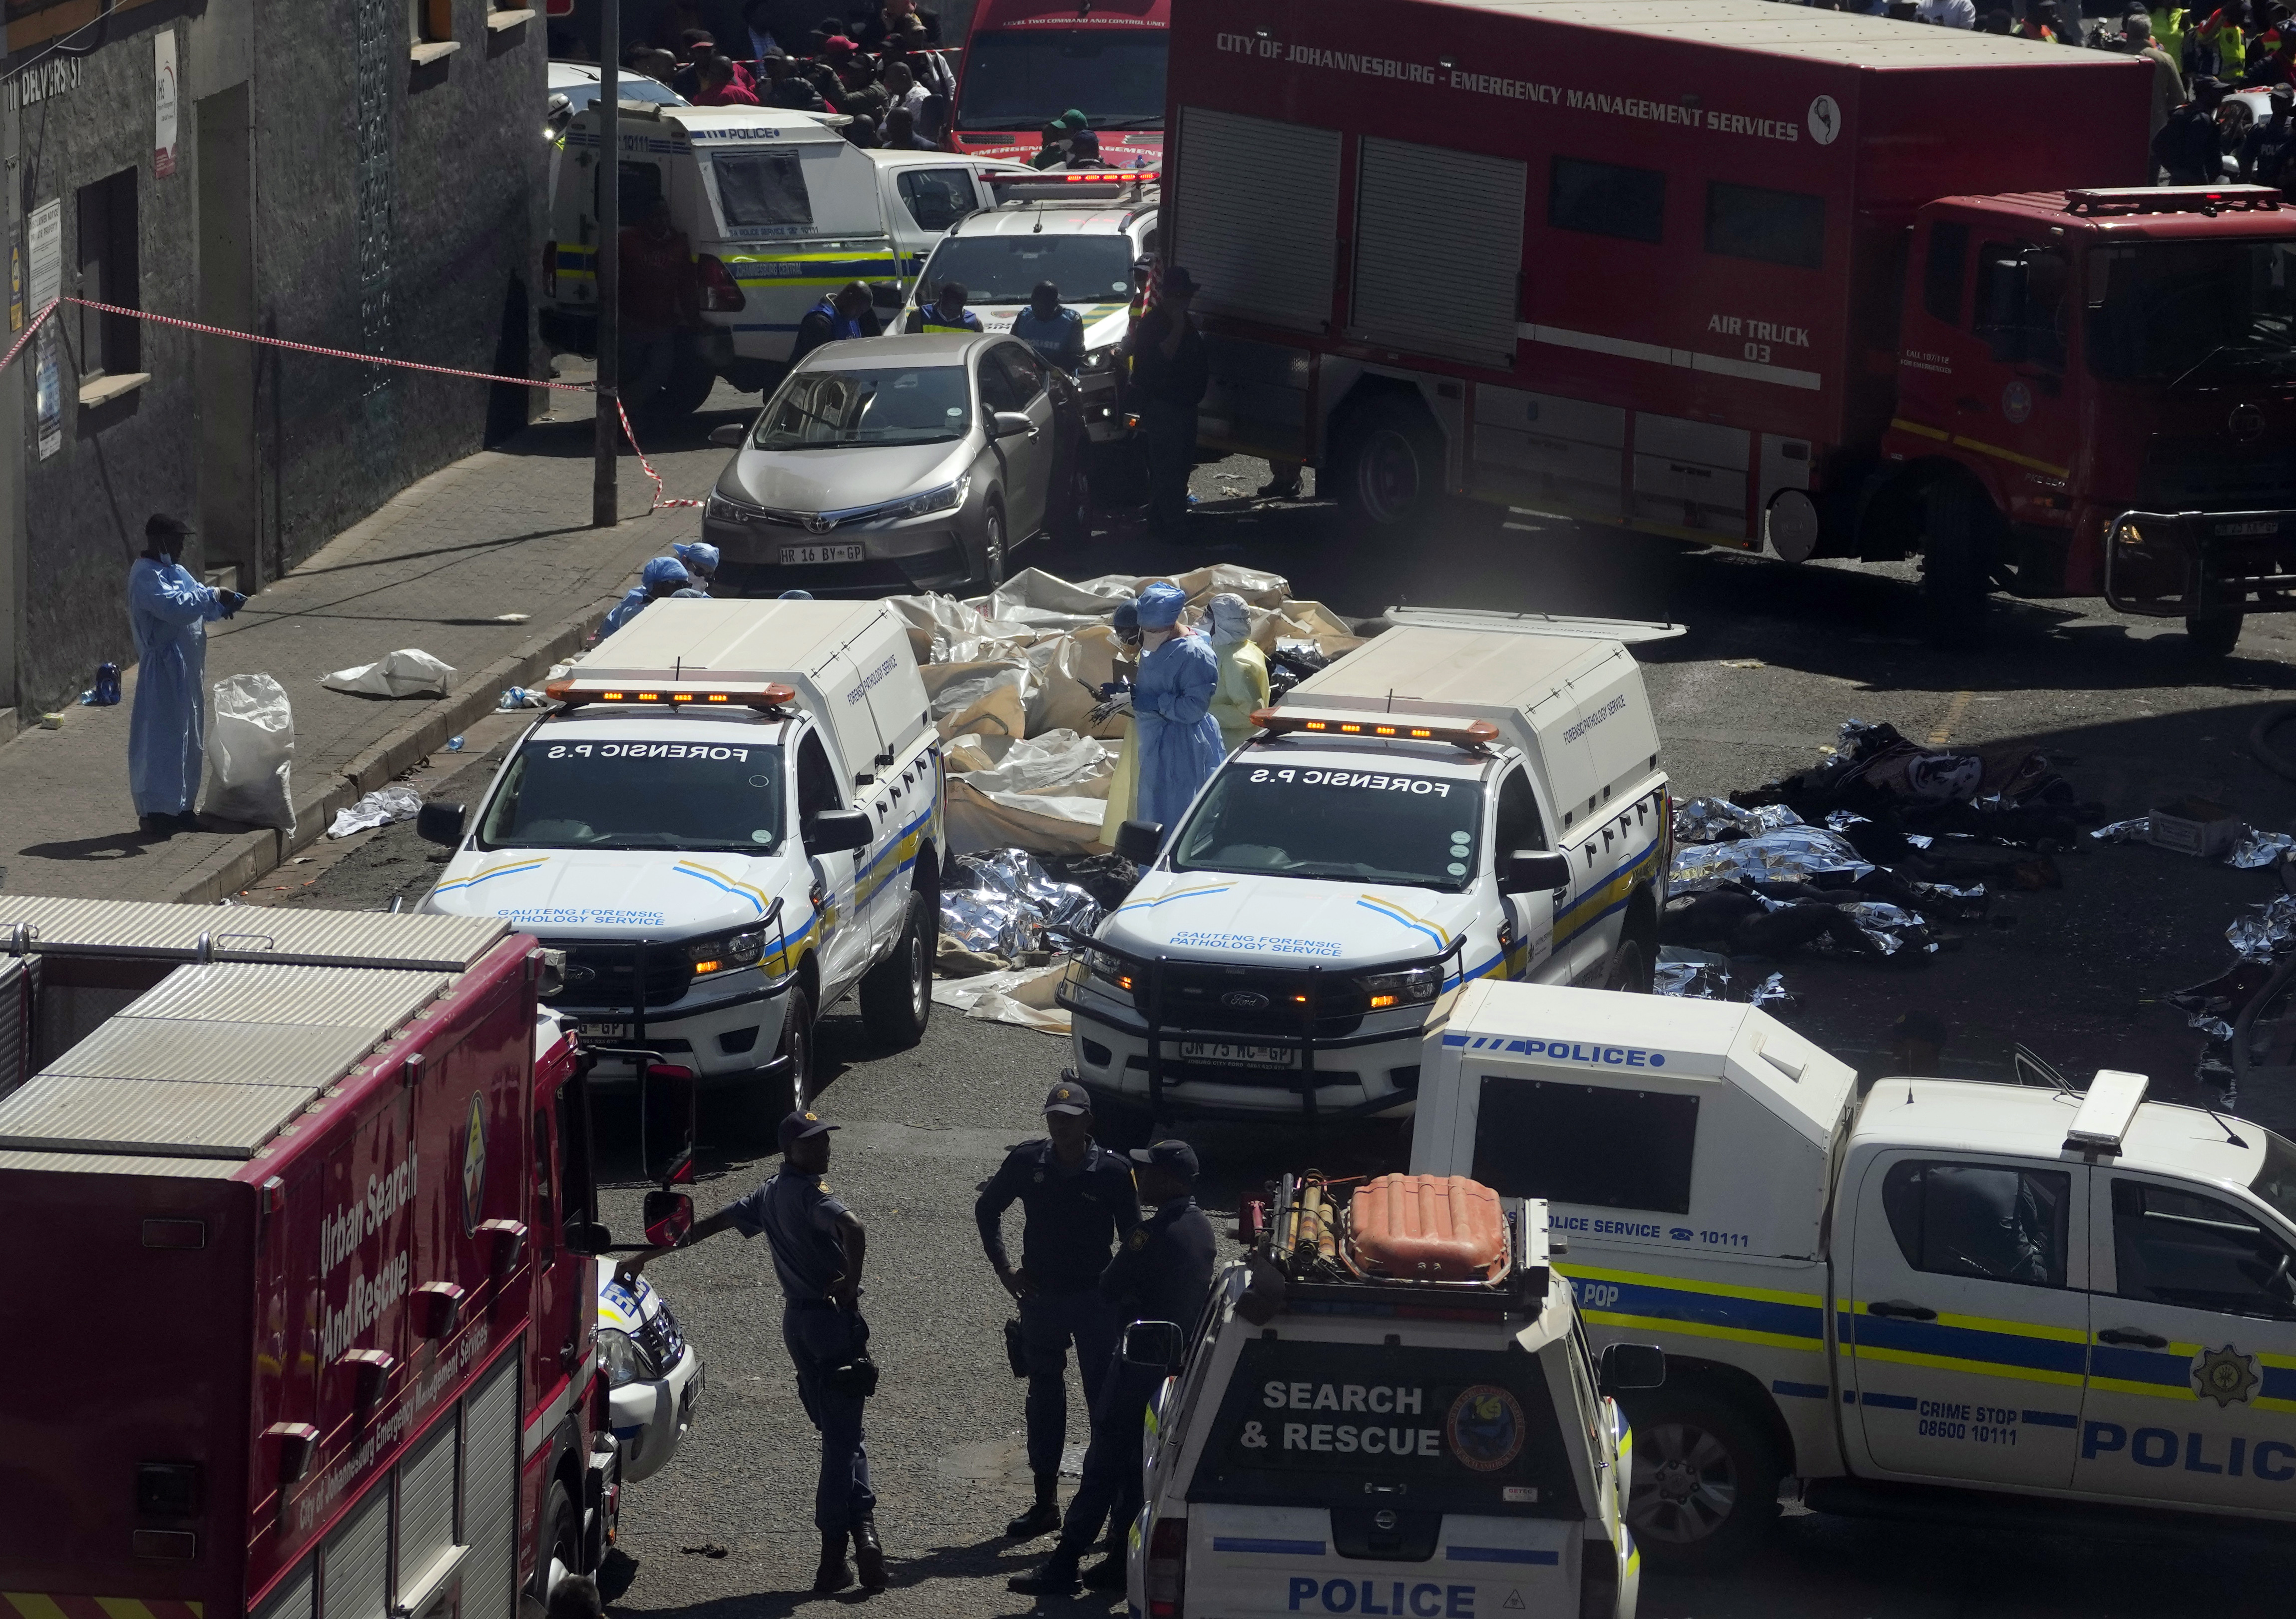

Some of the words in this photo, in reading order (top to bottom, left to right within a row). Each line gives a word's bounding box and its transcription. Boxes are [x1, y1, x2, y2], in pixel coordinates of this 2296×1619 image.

[22, 57, 66, 106] DELVERS
[70, 56, 81, 89] ST
[1217, 32, 1255, 55] CITY
[1260, 40, 1282, 59] OF
[1285, 44, 1434, 85] JOHANNESBURG
[1450, 70, 1562, 105] EMERGENCY
[1566, 89, 1703, 126] MANAGEMENT
[1707, 111, 1799, 142] SERVICES
[623, 134, 648, 151] 10111
[728, 127, 773, 139] POLICE
[1098, 145, 1163, 158] AGEMENT
[1708, 314, 1742, 335] AIR
[1747, 320, 1809, 347] TRUCK
[1745, 342, 1771, 363] 03
[1906, 349, 1920, 359] CALL
[781, 549, 795, 563] HR
[801, 548, 815, 562] 16
[822, 547, 836, 560] BY
[847, 546, 861, 559] GP
[863, 665, 884, 692] PATHOLOGY
[881, 654, 898, 676] SERVICE
[1563, 721, 1585, 745] FORENSIC
[1582, 705, 1608, 732] PATHOLOGY
[1607, 694, 1626, 716] SERVICE
[581, 909, 665, 918] FORENSIC
[594, 916, 666, 926] SERVICE
[1169, 937, 1266, 950] PATHOLOGY
[1271, 944, 1343, 957] SERVICE
[1177, 931, 1255, 942] GAUTENG
[1259, 937, 1343, 949] FORENSIC
[1230, 994, 1257, 1007] Ford
[601, 1024, 620, 1035] GP
[1185, 1042, 1204, 1055] JN
[1270, 1047, 1288, 1061] GP
[1524, 1041, 1647, 1067] POLICE
[321, 1200, 364, 1279] Urban
[366, 1140, 418, 1236] Search
[1548, 1217, 1589, 1230] OLICE
[1594, 1220, 1661, 1239] SERVICE
[1700, 1231, 1749, 1248] 10111
[1584, 1285, 1619, 1308] POP
[322, 1283, 353, 1369] And
[354, 1250, 408, 1339] Rescue
[1263, 1381, 1422, 1415] SEARCH
[1920, 1401, 1971, 1422] CRIME
[1976, 1406, 2017, 1426] STOP
[300, 1497, 314, 1530] City
[316, 1486, 325, 1514] of
[325, 1438, 376, 1505] Johannesburg
[376, 1397, 414, 1453] Emergency
[415, 1353, 459, 1413] Management
[460, 1323, 488, 1369] Services
[1240, 1421, 1268, 1448] &
[1283, 1423, 1441, 1457] RESCUE
[1919, 1419, 1966, 1441] 08600
[1972, 1424, 2017, 1446] 10111
[2081, 1420, 2296, 1482] POLIC
[1289, 1577, 1476, 1619] POLICE
